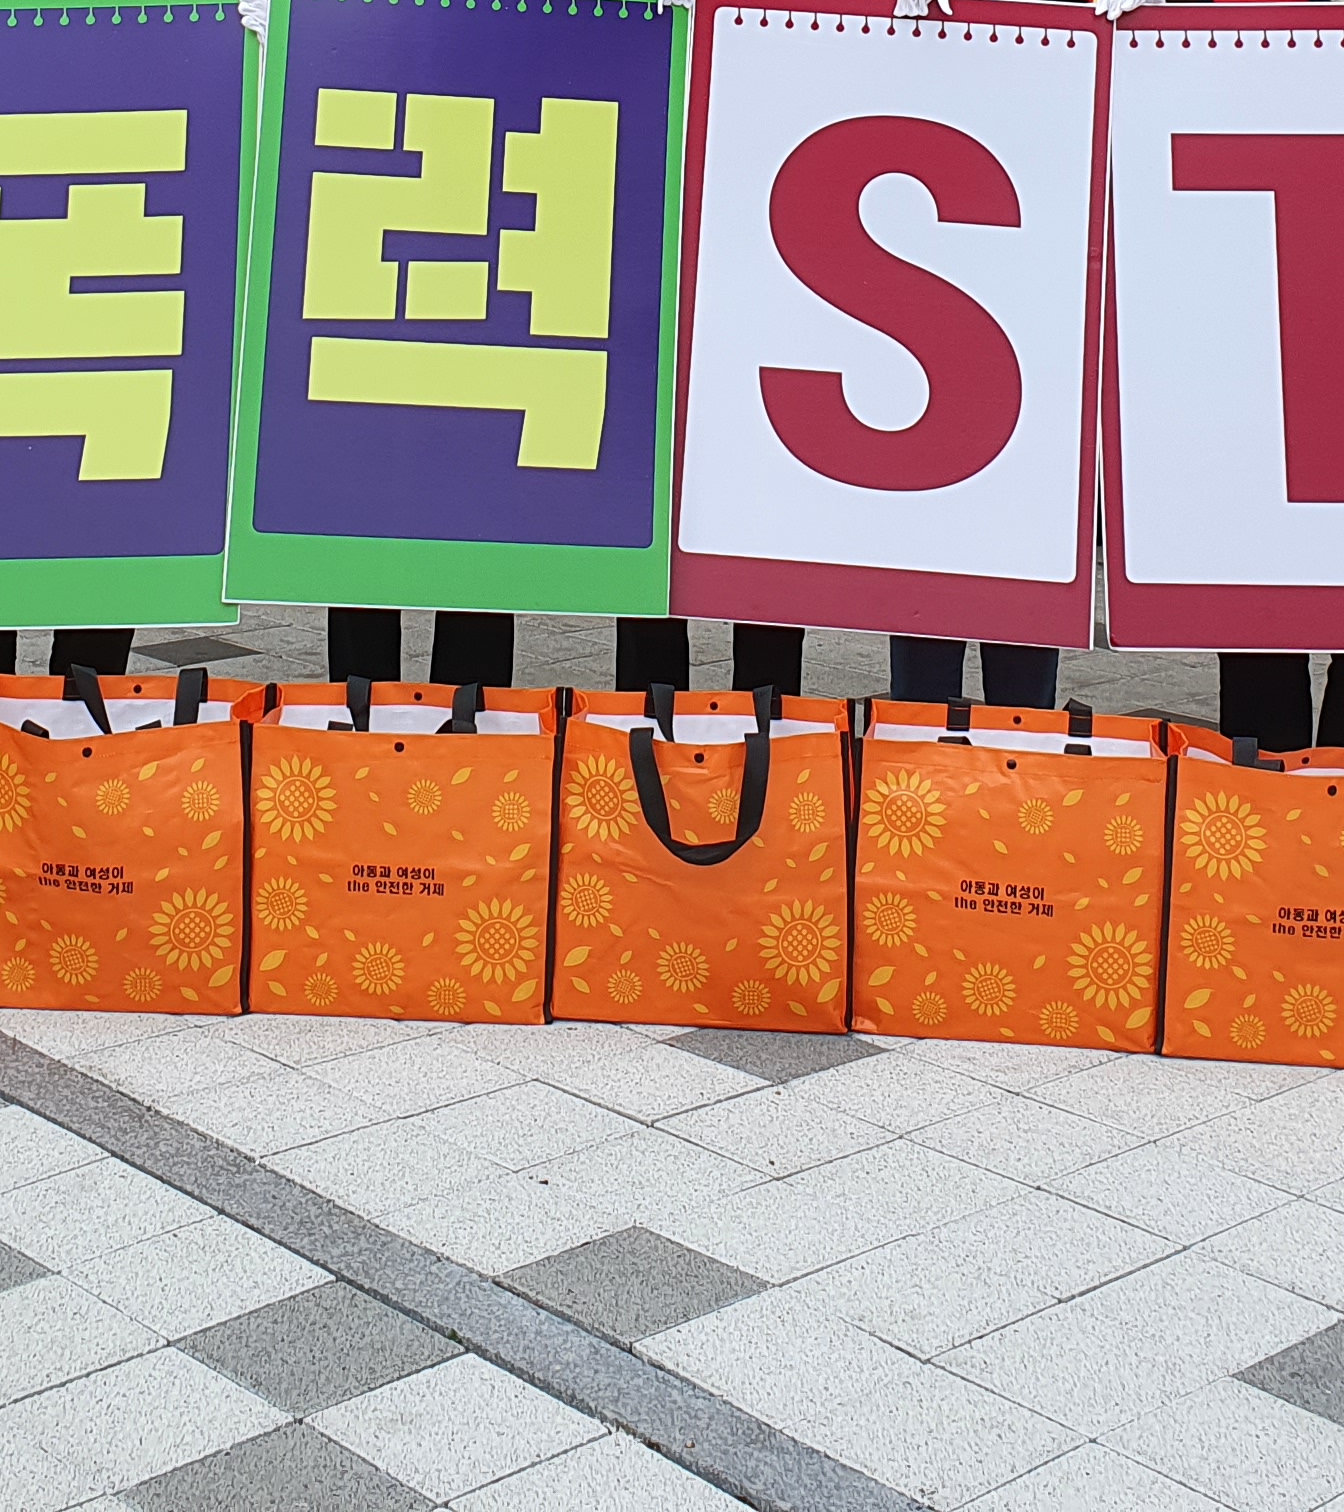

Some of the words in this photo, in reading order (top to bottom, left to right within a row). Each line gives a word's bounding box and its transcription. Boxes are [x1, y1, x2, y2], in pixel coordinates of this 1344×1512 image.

[41, 863, 80, 878] 아동과
[84, 866, 124, 880] 여성이
[352, 864, 392, 879] 아동과
[396, 866, 435, 881] 여성이
[38, 876, 61, 888] the
[64, 878, 103, 894] 안전한
[107, 881, 134, 896] 거제
[347, 880, 370, 892] the
[375, 880, 414, 896] 안전한
[419, 882, 445, 897] 거제
[960, 880, 1000, 896] 아동과
[1005, 884, 1045, 901] 여성이
[954, 896, 977, 911] the
[982, 899, 1023, 915] 안전한
[1027, 902, 1054, 918] 거제
[1278, 907, 1319, 923] 아동과
[1272, 922, 1296, 936] the
[1301, 924, 1343, 940] 안전한
